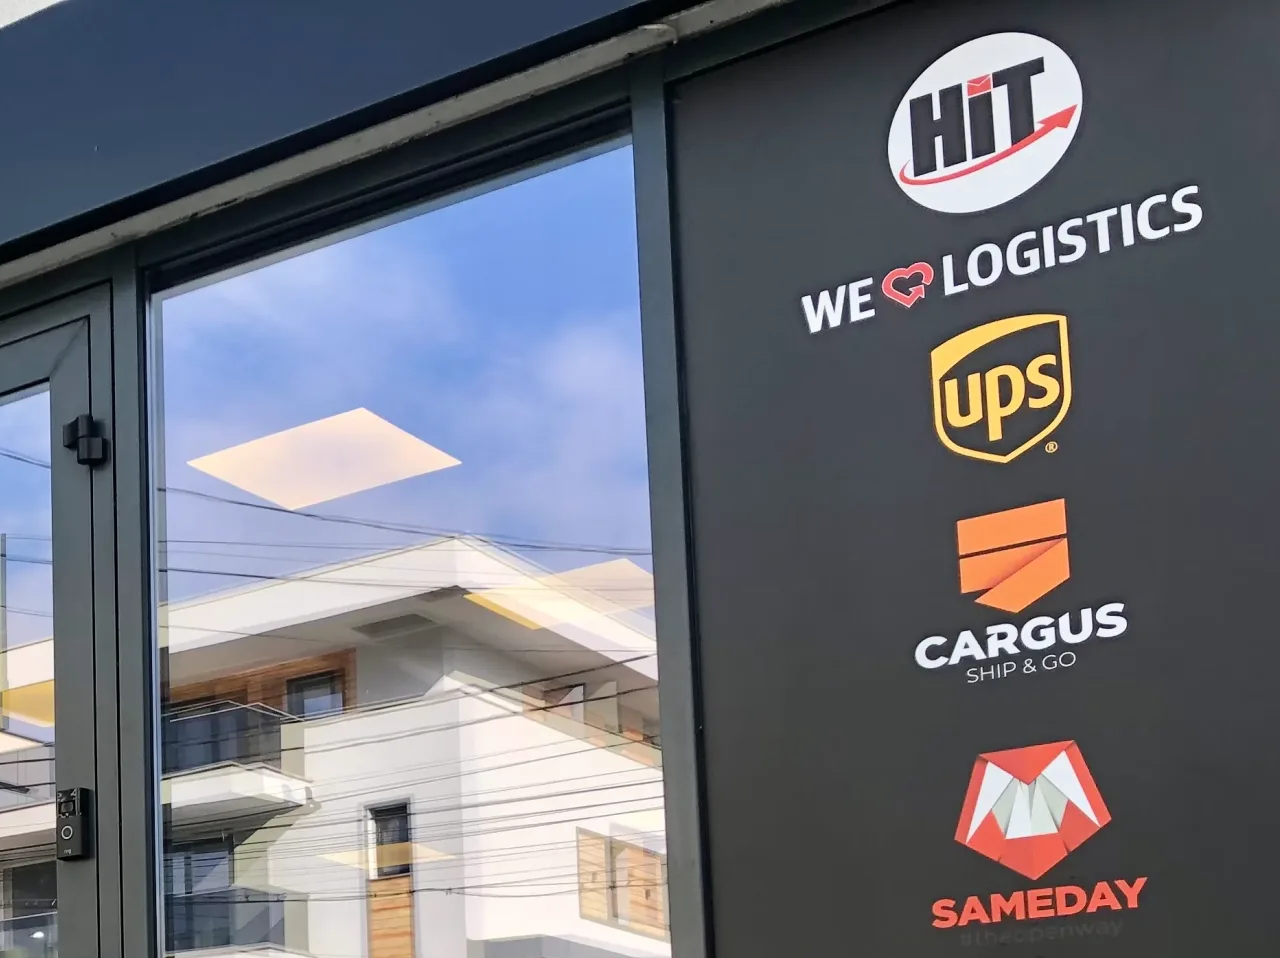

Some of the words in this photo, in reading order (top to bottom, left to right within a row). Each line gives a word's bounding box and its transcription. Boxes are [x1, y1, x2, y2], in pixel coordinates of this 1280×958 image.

[801, 276, 875, 334] WE
[942, 185, 1203, 297] LOGISTICS
[914, 601, 1128, 670] CARGUS
[966, 659, 1017, 684] SHIP
[1022, 658, 1037, 675] &
[1042, 650, 1076, 671] GO
[931, 876, 1148, 929] SAMEDAY
